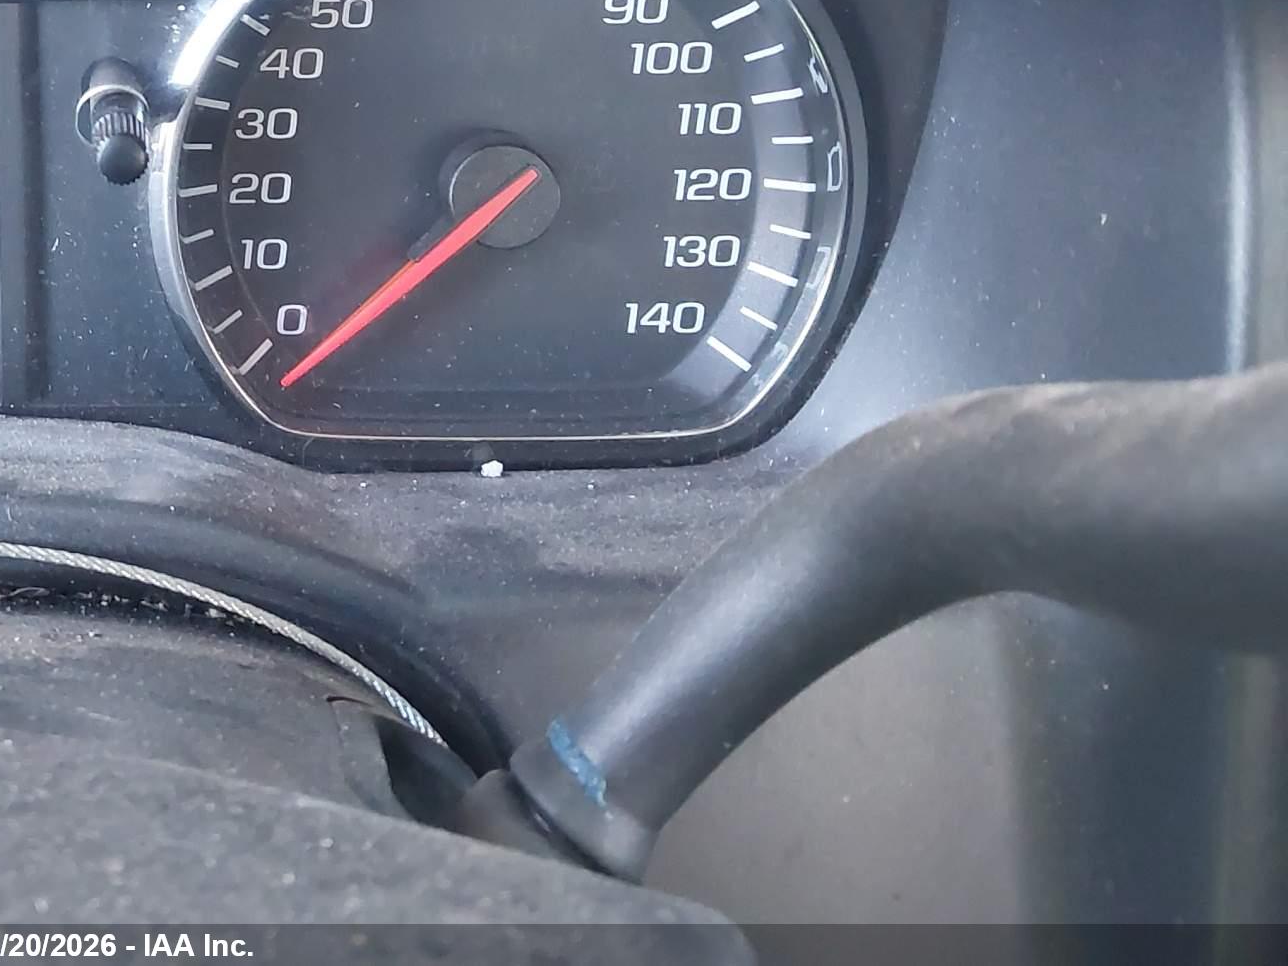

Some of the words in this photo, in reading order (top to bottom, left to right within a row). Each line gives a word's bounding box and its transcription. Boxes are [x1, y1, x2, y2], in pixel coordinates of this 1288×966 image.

[260, 48, 324, 79] 40
[631, 41, 713, 75] 100
[235, 108, 298, 139] 30
[678, 102, 742, 135] 110
[229, 173, 292, 204] 20
[673, 168, 752, 201] 120
[241, 238, 288, 270] 10
[663, 235, 741, 268] 130
[276, 304, 308, 335] 0
[625, 302, 705, 334] 140
